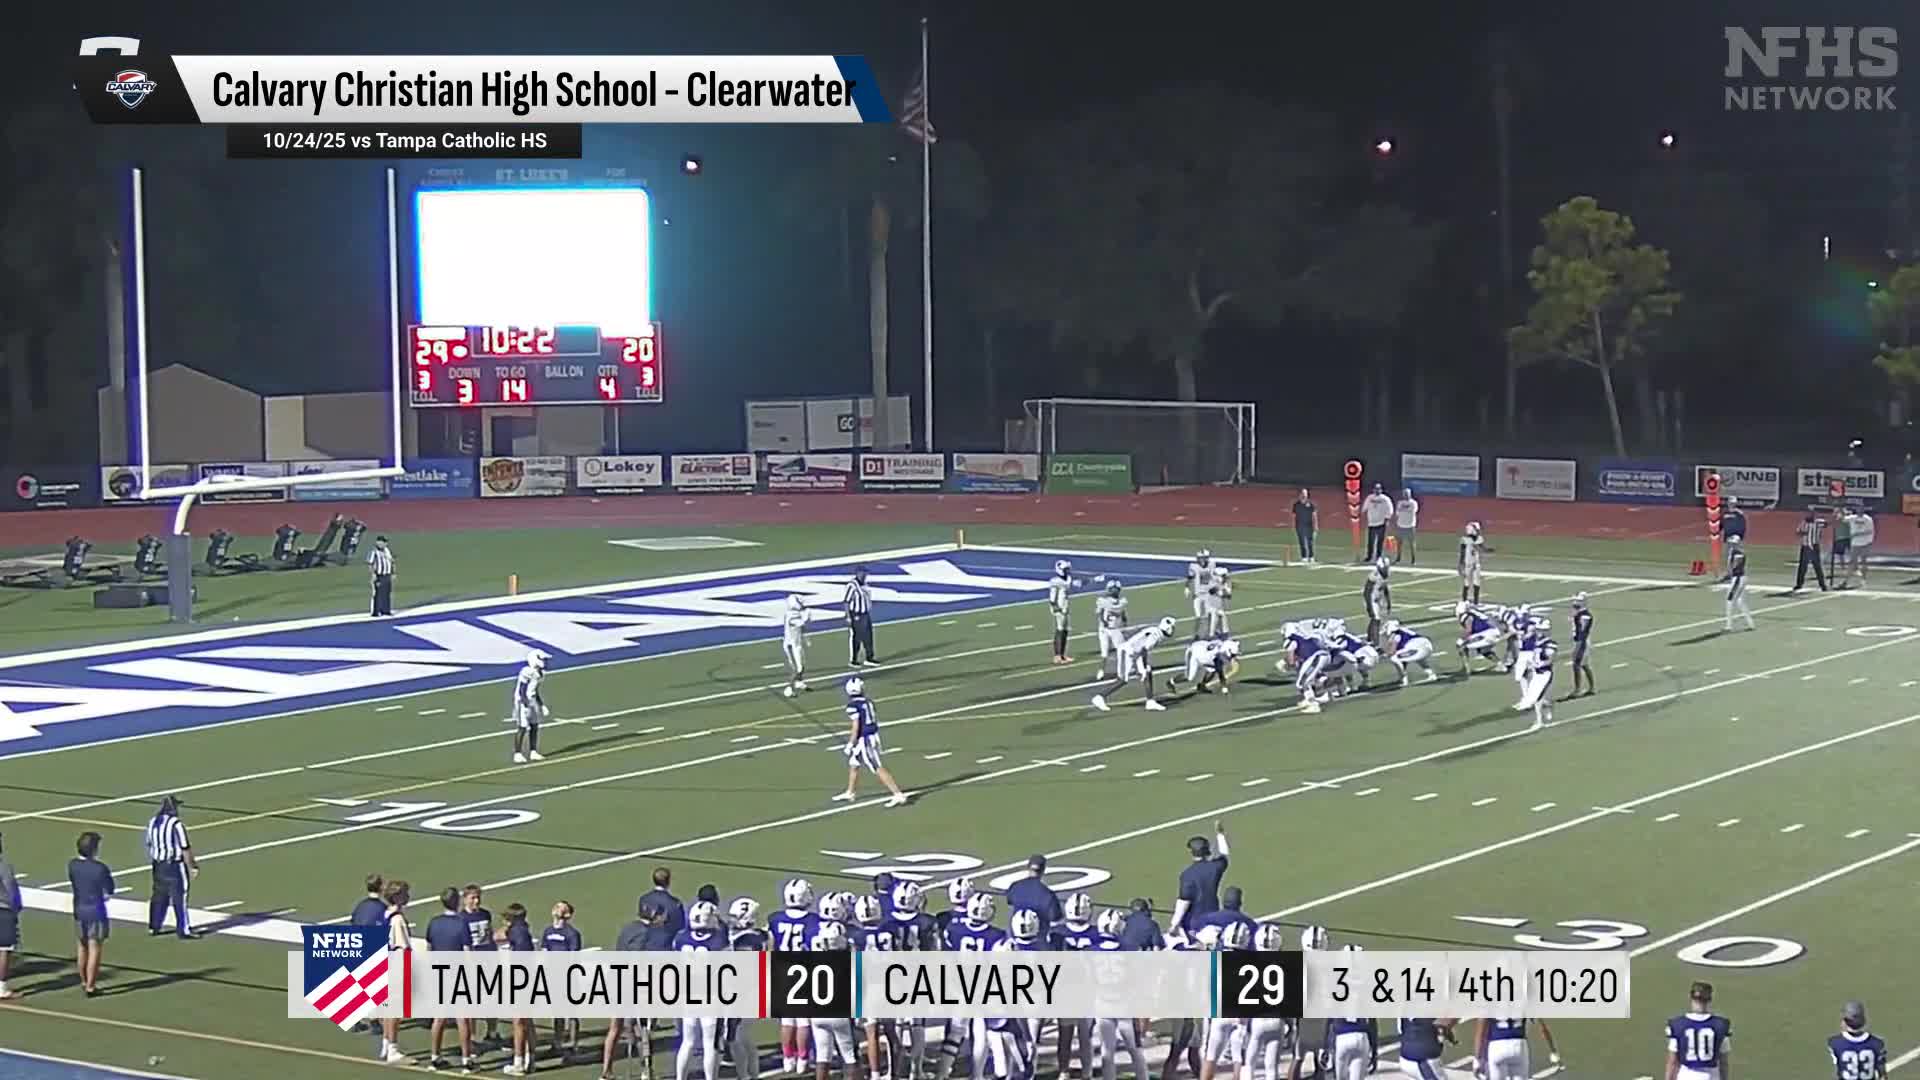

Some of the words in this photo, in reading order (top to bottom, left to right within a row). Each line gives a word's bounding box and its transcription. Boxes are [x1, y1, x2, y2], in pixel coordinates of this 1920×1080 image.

[483, 326, 555, 353] 10:22
[622, 338, 654, 362] 20
[416, 340, 448, 366] 29
[418, 369, 431, 390] 3
[447, 366, 481, 379] DOWN
[598, 364, 618, 377] QTR
[641, 366, 654, 387] 3
[457, 379, 472, 403] 3
[502, 379, 527, 401] 14
[600, 377, 617, 399] 4
[603, 461, 655, 475] Lokey
[865, 461, 882, 473] D1
[1512, 919, 1804, 968] 30
[1684, 1028, 1714, 1061] 10
[1842, 1050, 1874, 1080] 33
